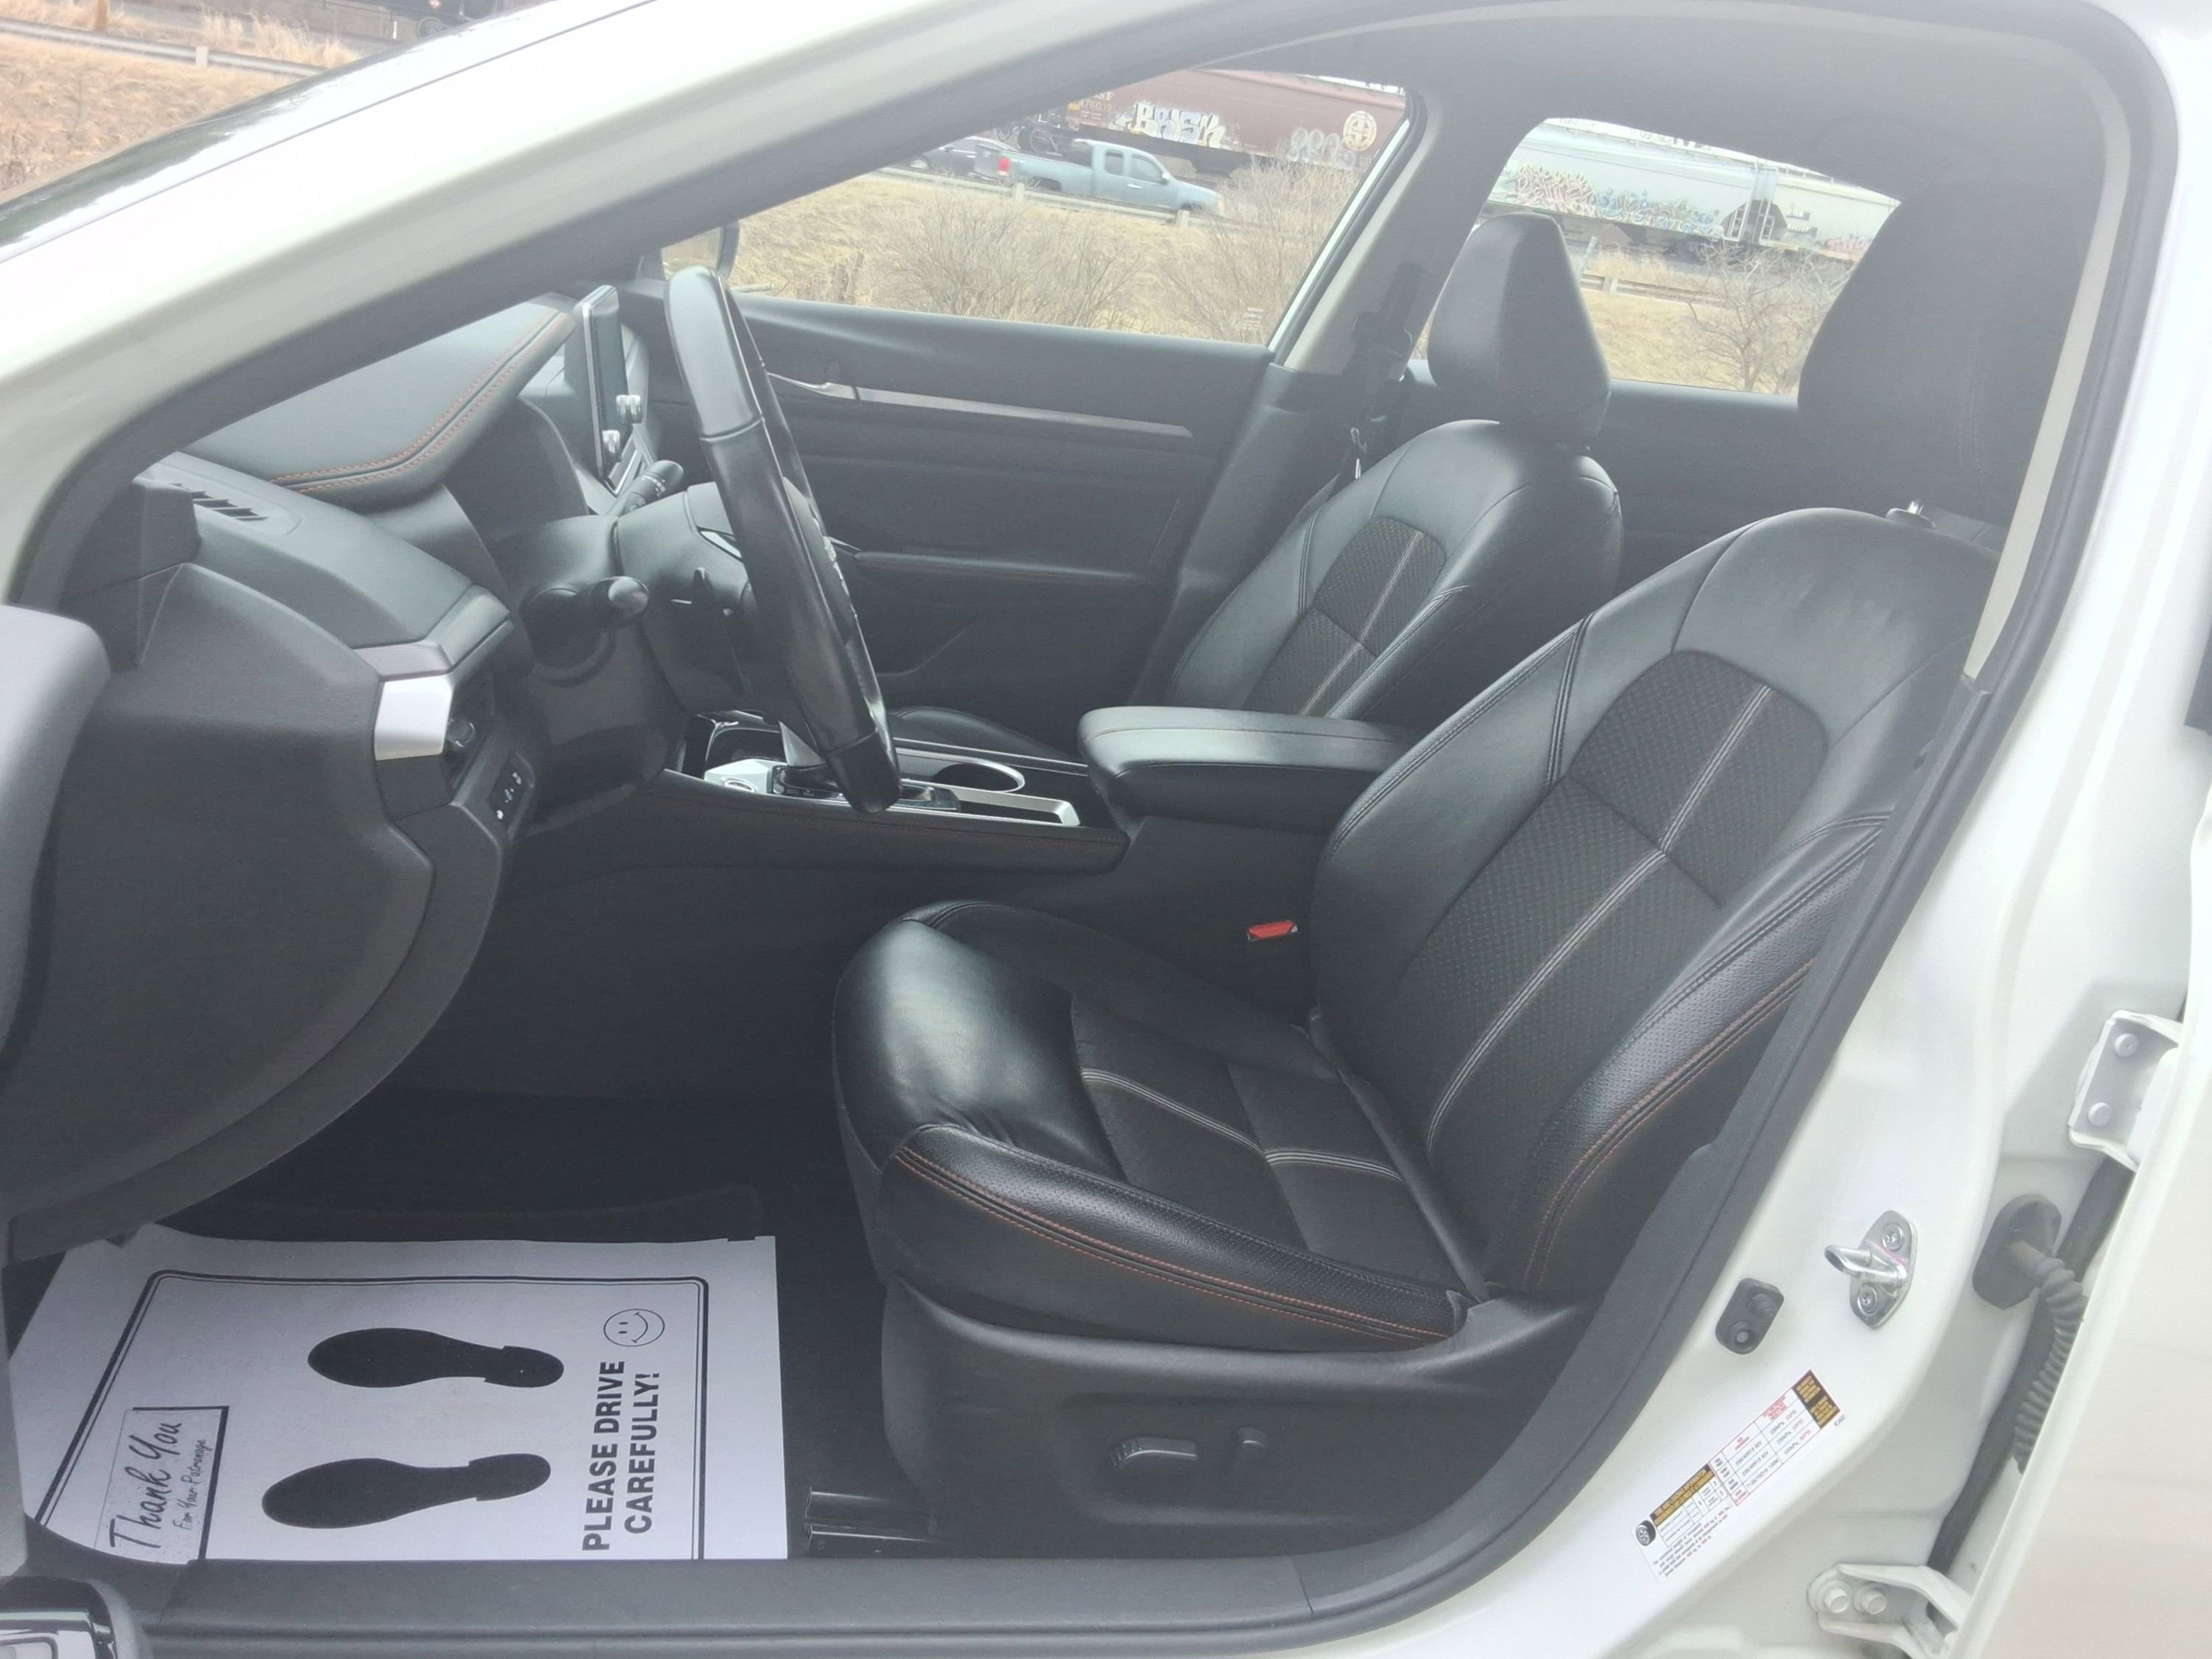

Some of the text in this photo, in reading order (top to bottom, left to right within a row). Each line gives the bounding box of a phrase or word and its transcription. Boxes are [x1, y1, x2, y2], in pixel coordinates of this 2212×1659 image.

[109, 1422, 182, 1548] Thank You
[173, 1439, 214, 1531] For Your Patronage
[582, 1361, 625, 1551] PLEASE DRIVE
[624, 1373, 660, 1534] CAREFULLY!
